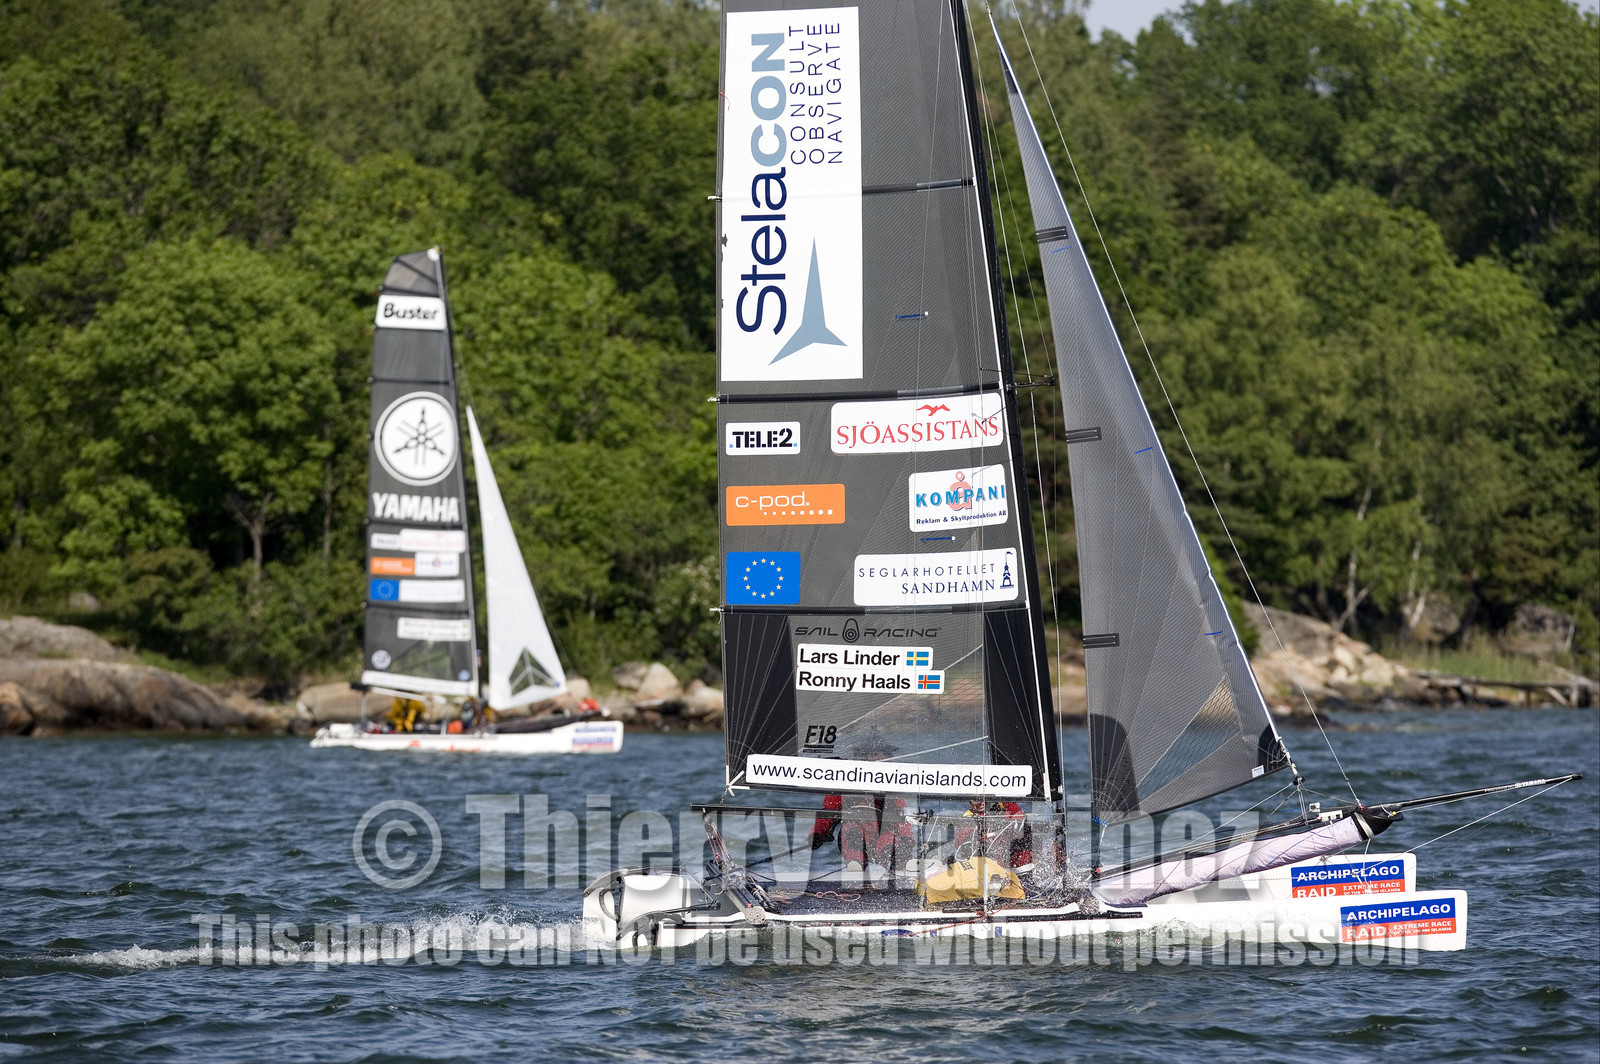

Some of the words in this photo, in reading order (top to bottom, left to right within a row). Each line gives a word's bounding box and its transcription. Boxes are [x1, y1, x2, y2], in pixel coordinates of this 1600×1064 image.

[788, 25, 806, 165] CONSULT
[807, 23, 824, 164] OBSERVE
[825, 22, 843, 164] NAVIGATE
[383, 303, 438, 320] Buster
[836, 416, 998, 449] SJÖASSISTANS
[915, 484, 1006, 508] KOMPANI
[372, 492, 460, 522] YAMAHA
[950, 511, 997, 522] Skyltproduktion
[858, 563, 995, 578] SEGLARHOTELLET
[901, 579, 996, 595] SANDHAMN
[794, 627, 839, 636] SAIL
[800, 648, 838, 664] Lars
[843, 650, 900, 666] Linder
[799, 671, 857, 691] Ronny
[862, 673, 911, 690] Haals
[804, 725, 838, 744] F18
[752, 763, 1026, 789] www.scandinavianislands.com
[1297, 865, 1400, 882] ARCHIPELAGO
[1380, 881, 1401, 889] RACE
[1346, 904, 1451, 921] ARCHIPELAGO
[1346, 926, 1387, 940] RAID
[1393, 923, 1430, 931] EXTREME
[1431, 920, 1452, 928] RACE
